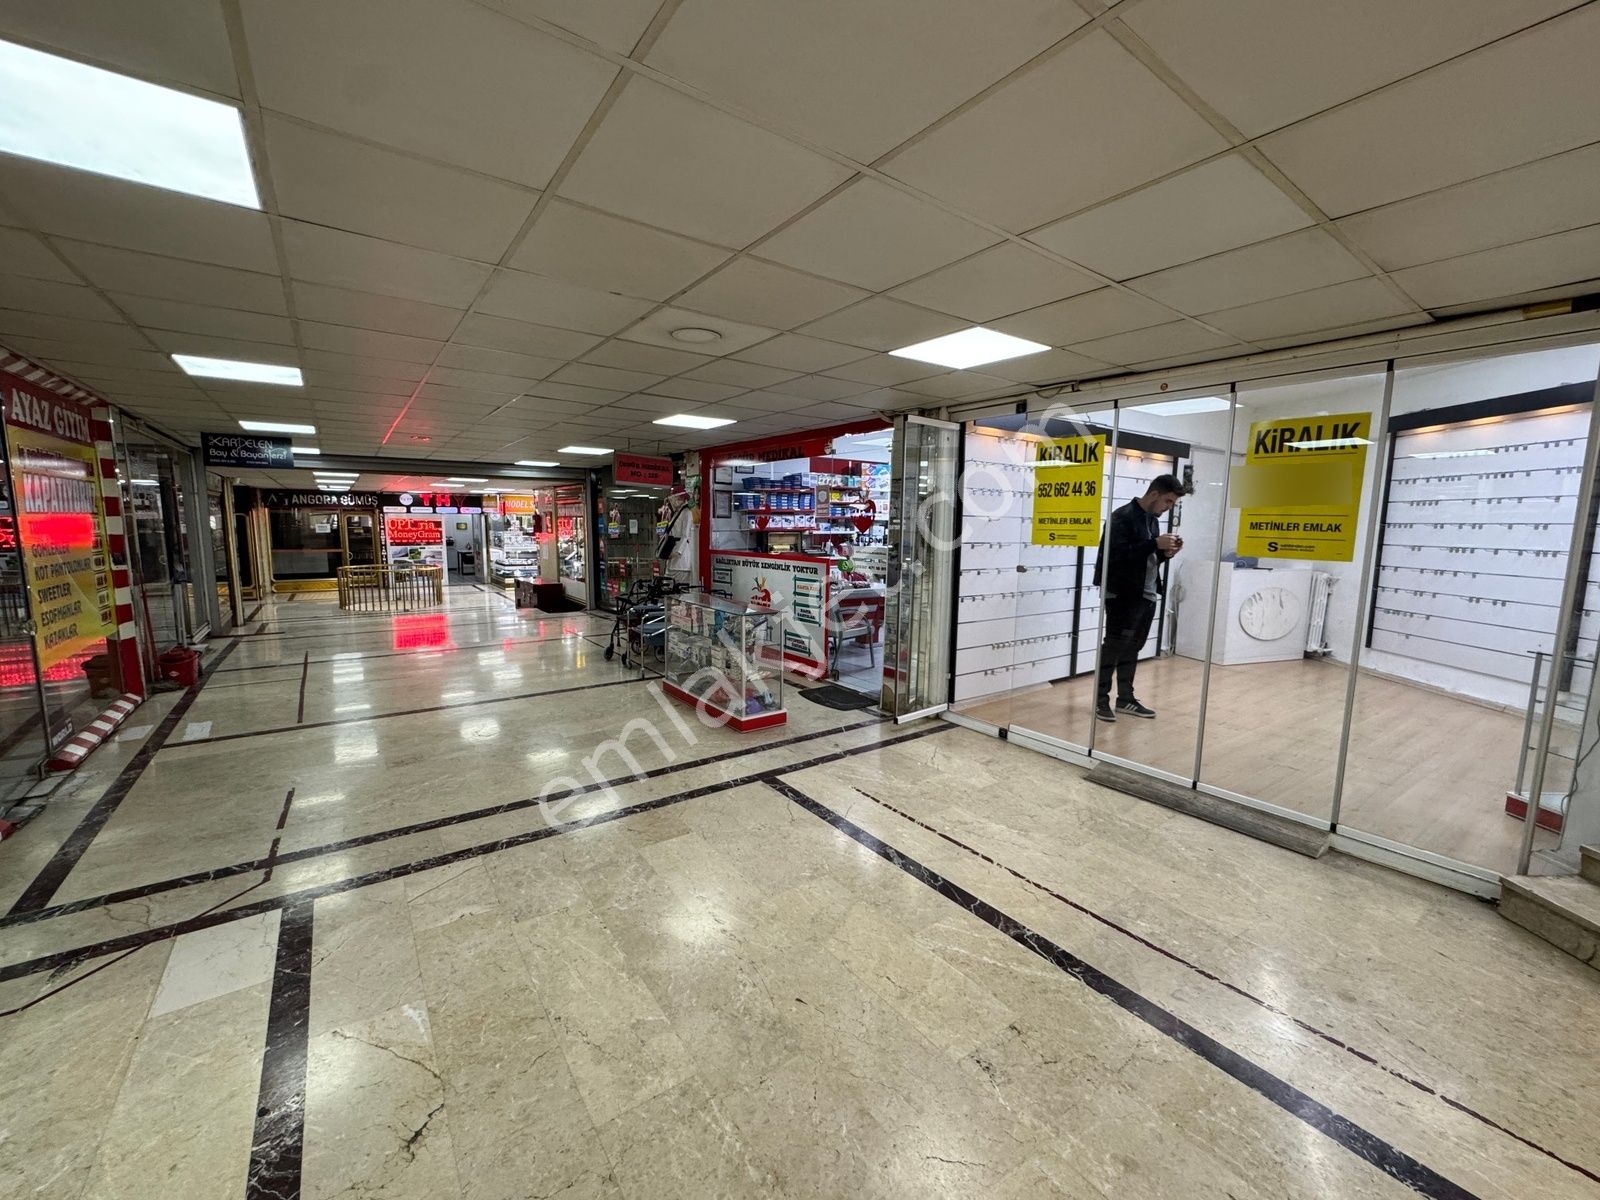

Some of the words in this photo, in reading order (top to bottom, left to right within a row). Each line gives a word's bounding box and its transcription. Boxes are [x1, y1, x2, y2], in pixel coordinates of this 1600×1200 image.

[12, 388, 51, 431] AYAZ
[54, 402, 91, 442] GİYİM
[210, 448, 228, 458] Bay
[230, 448, 239, 457] &
[240, 449, 268, 460] Bayan
[1038, 483, 1052, 498] 552
[1054, 482, 1069, 497] 662
[1071, 481, 1082, 496] 44
[1084, 480, 1096, 496] 36
[292, 494, 338, 504] ANGORA
[340, 494, 379, 507] GÜMÜŞ
[1038, 516, 1068, 525] METİNLER
[1249, 521, 1300, 532] METİNLER
[1303, 522, 1342, 533] EMLAK
[388, 530, 441, 540] MoneyGram
[35, 564, 49, 580] KOT
[742, 559, 760, 569] BÜYÜK
[761, 561, 791, 572] ZENGİNLİK
[792, 566, 819, 575] YOKTUR
[38, 582, 72, 604] SWEETLER
